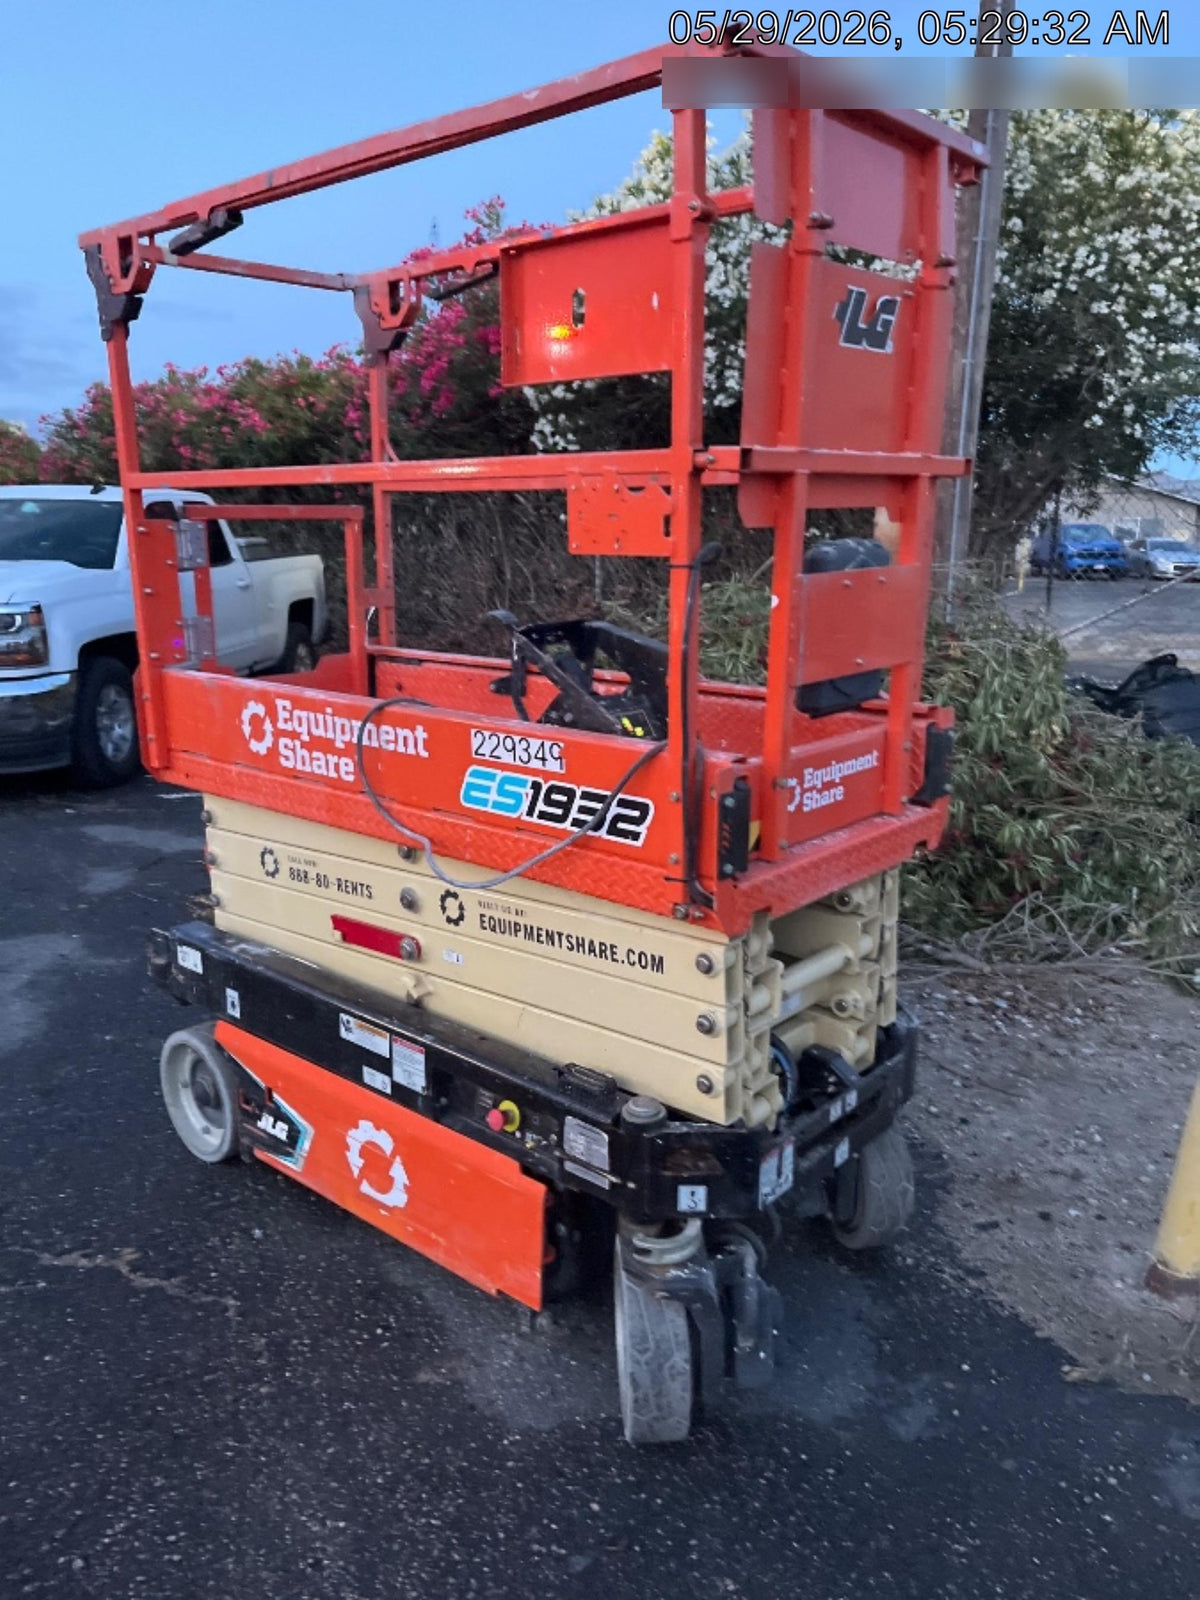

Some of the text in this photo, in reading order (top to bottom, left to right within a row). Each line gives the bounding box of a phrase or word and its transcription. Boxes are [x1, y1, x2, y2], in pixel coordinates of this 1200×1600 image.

[275, 698, 429, 758] Equipment
[278, 737, 355, 782] Share
[474, 730, 564, 770] 229349
[803, 750, 879, 788] Equipment
[461, 766, 654, 845] ES1932
[803, 785, 844, 812] Share
[289, 867, 373, 899] 888-80-RENTS
[479, 913, 664, 975] EQUIPMENTSHARE.COM
[257, 1112, 289, 1142] JLG
